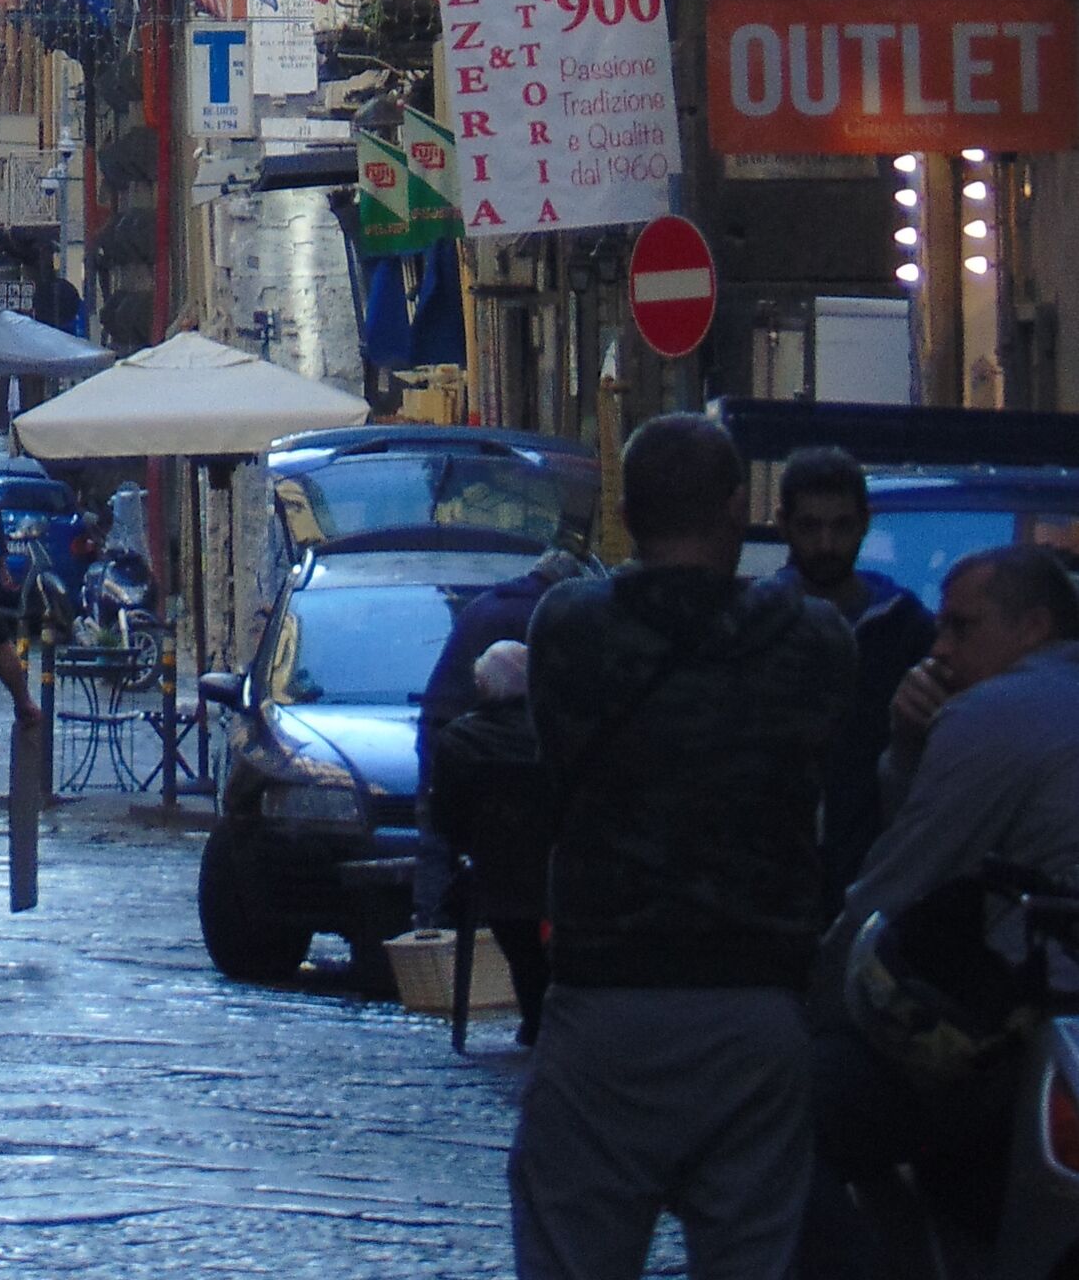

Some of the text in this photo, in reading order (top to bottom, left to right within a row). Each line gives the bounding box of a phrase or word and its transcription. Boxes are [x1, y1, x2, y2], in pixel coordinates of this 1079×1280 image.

[193, 30, 247, 104] T
[488, 45, 516, 70] &
[559, 55, 656, 82] Passione
[728, 22, 1055, 118] OUTLET
[559, 88, 665, 116] Tradizione
[568, 134, 581, 151] e
[571, 153, 668, 186] dal 1960
